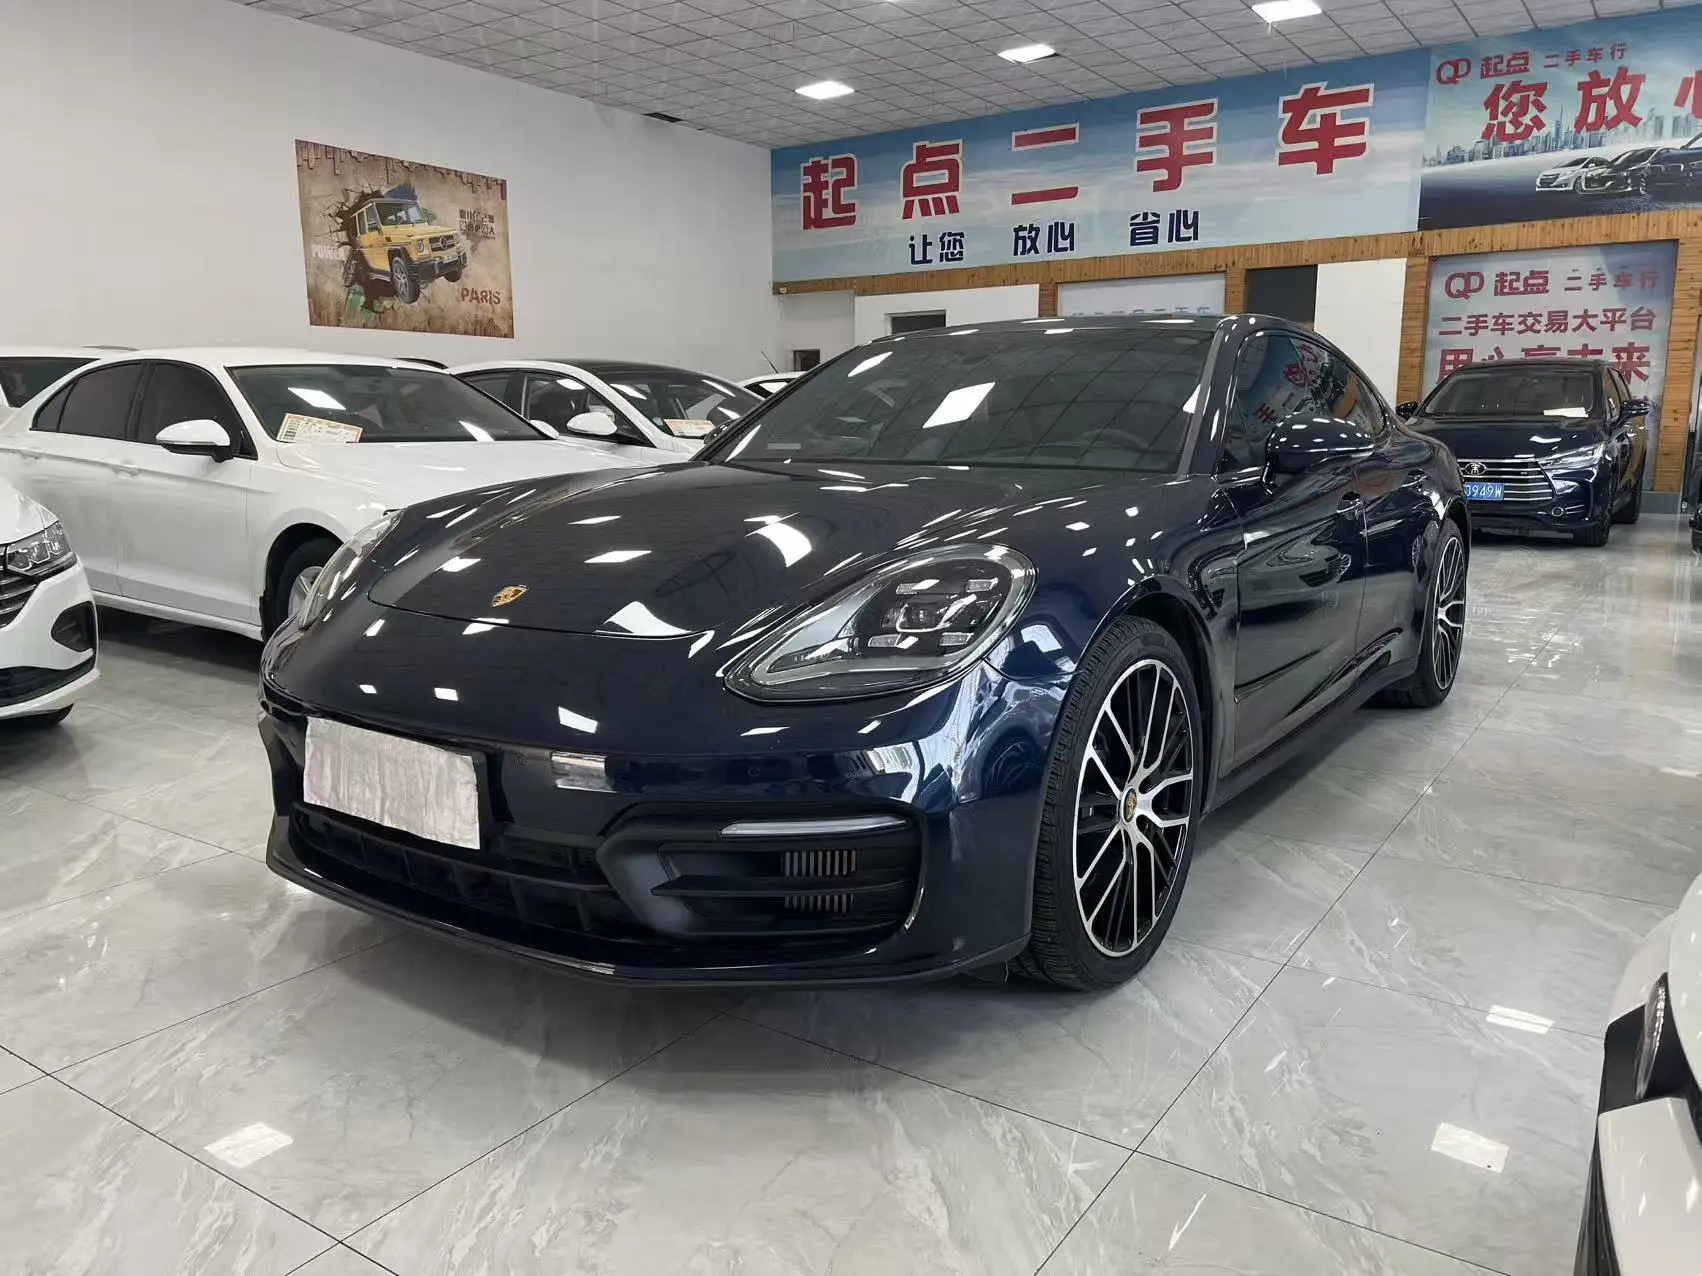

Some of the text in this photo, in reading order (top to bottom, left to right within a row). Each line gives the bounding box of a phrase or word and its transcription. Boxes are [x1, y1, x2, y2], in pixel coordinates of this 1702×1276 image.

[1480, 50, 1530, 79] 起点
[1543, 40, 1627, 69] 二手车行
[802, 84, 1371, 230] 起点二手车
[908, 209, 1200, 265] 让您 放心 省心
[461, 287, 501, 305] PARIS
[1493, 270, 1550, 297] 起点
[1564, 272, 1661, 292] 二手车行
[1438, 306, 1657, 337] 二手车交易大平台
